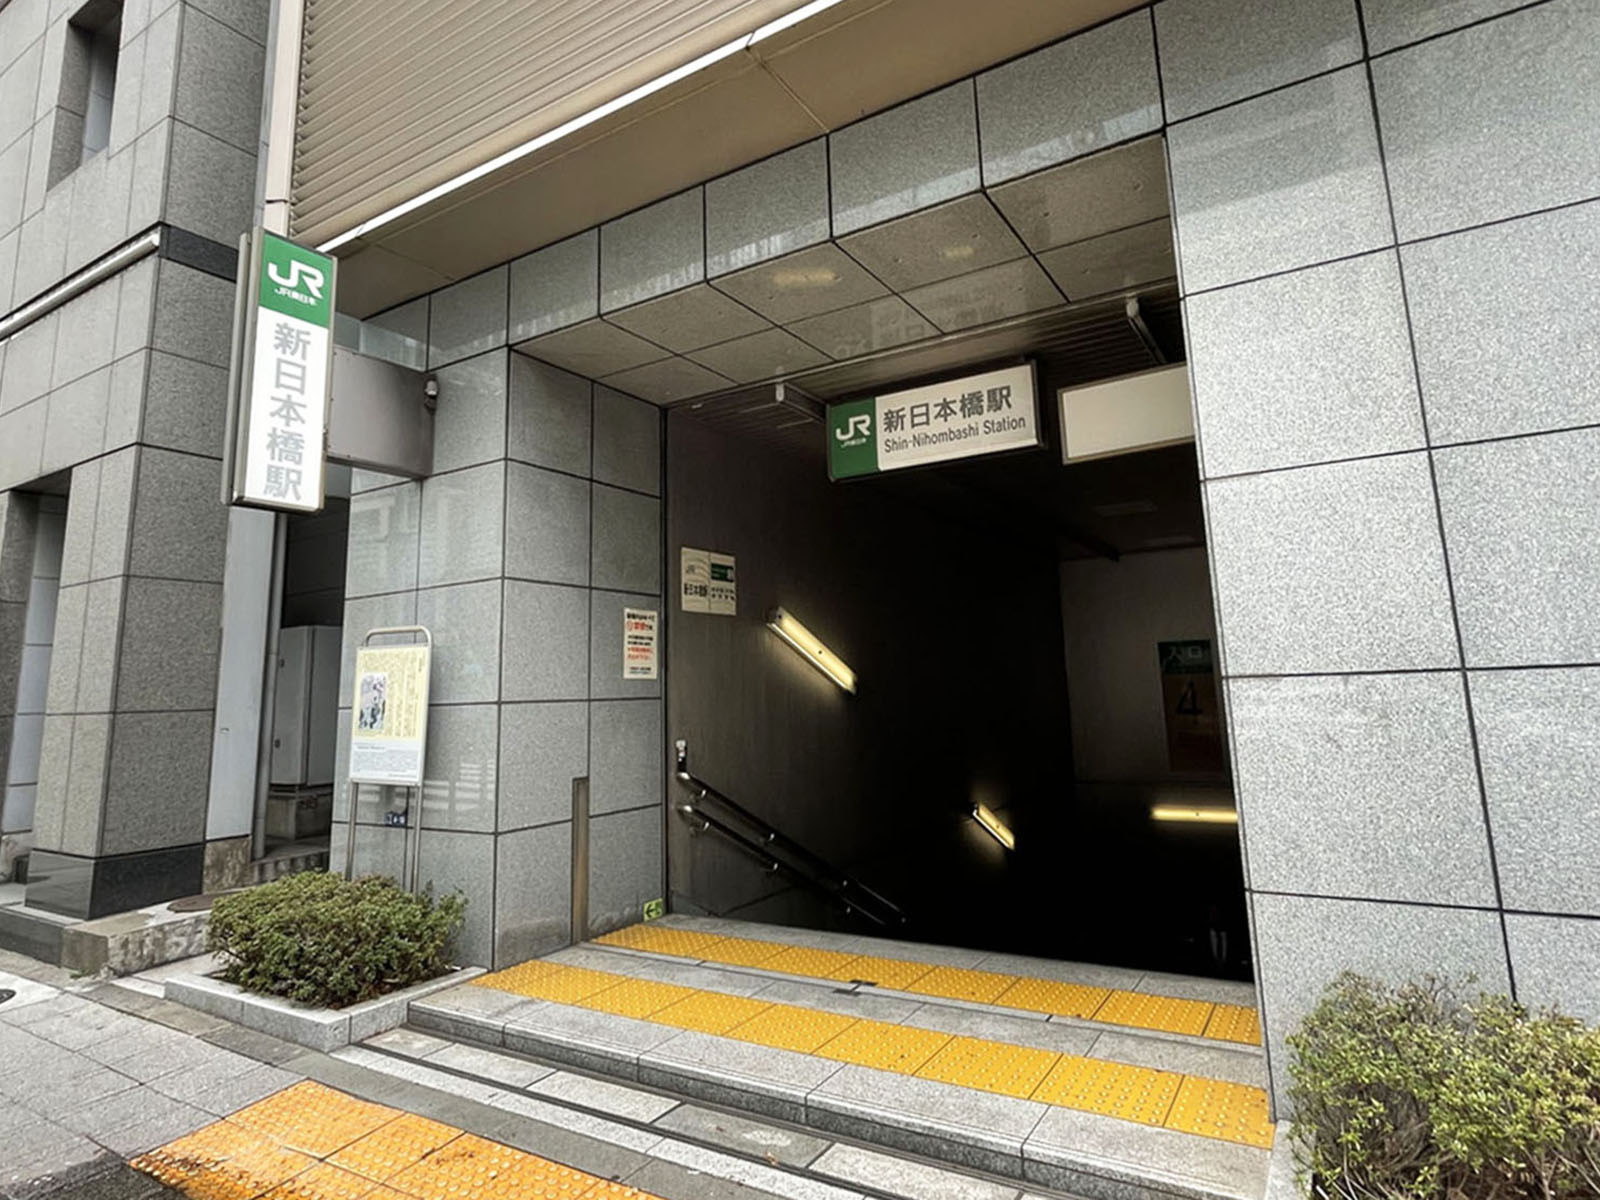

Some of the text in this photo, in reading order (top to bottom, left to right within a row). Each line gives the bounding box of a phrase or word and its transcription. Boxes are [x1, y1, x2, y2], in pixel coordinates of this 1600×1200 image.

[267, 259, 324, 299] JR
[263, 322, 311, 501] 新日本橋駅
[836, 414, 871, 441] JR
[883, 385, 1012, 433] 新日本橋駅
[884, 421, 980, 454] Shin-Nihombashi
[983, 415, 1026, 436] Station
